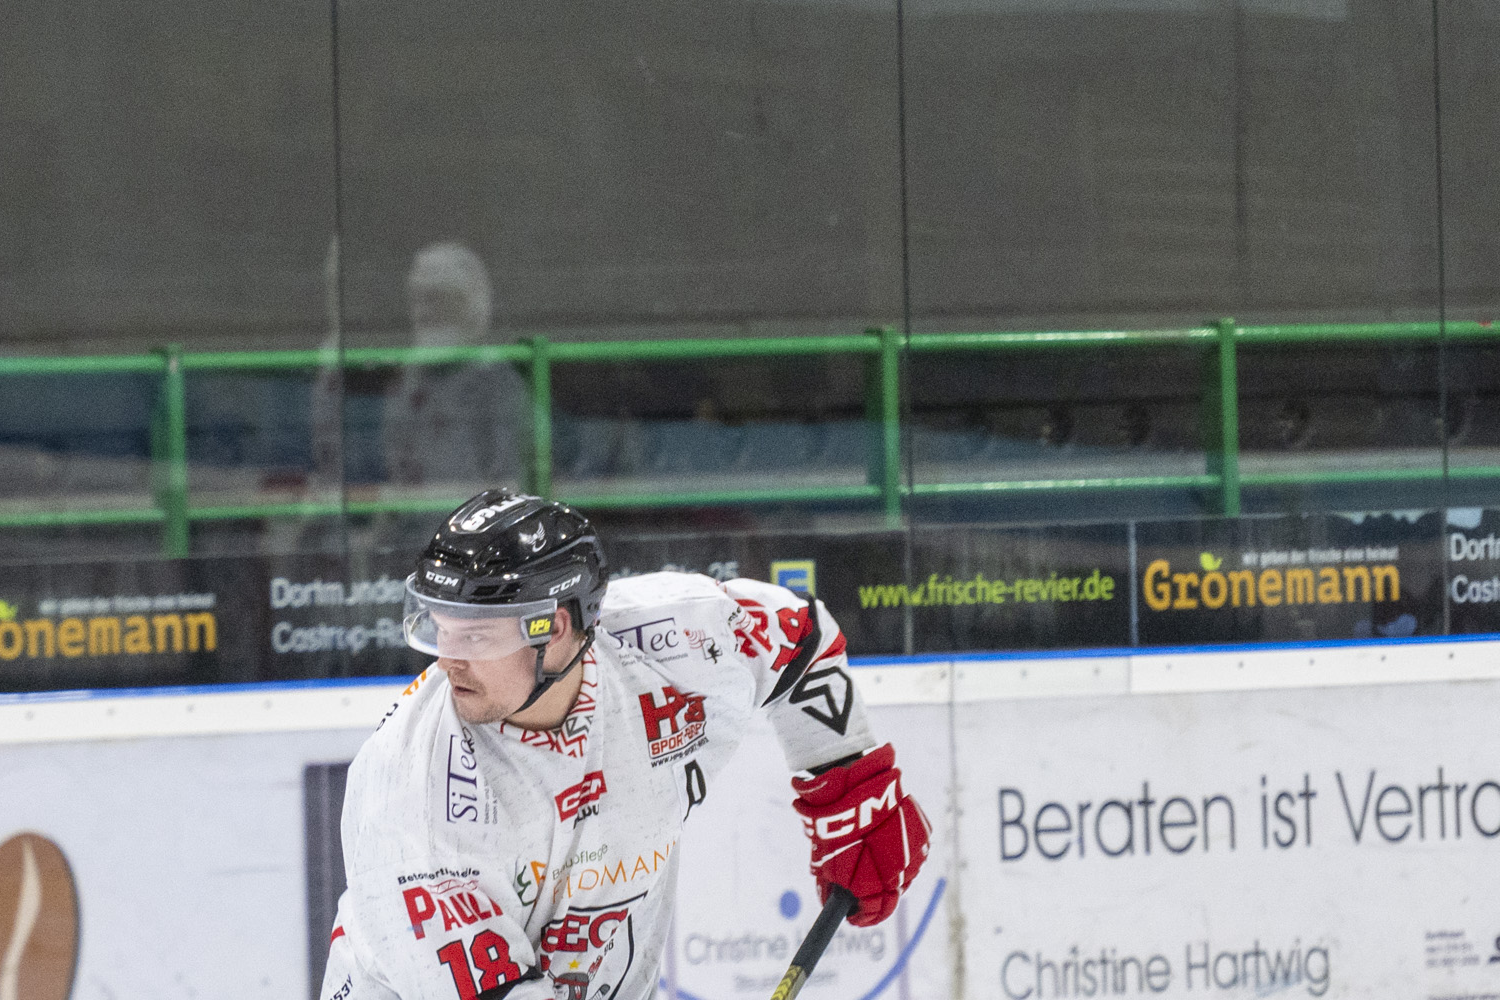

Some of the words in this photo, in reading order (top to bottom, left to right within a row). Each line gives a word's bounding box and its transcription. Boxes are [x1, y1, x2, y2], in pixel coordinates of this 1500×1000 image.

[269, 574, 406, 609] Dortmunde
[425, 570, 460, 588] CCM
[549, 574, 582, 596] CCM
[858, 567, 1116, 609] www.frische-revier.de
[998, 781, 1236, 861] Beraten
[1260, 773, 1317, 849] ist
[1185, 939, 1331, 998] Hartwig
